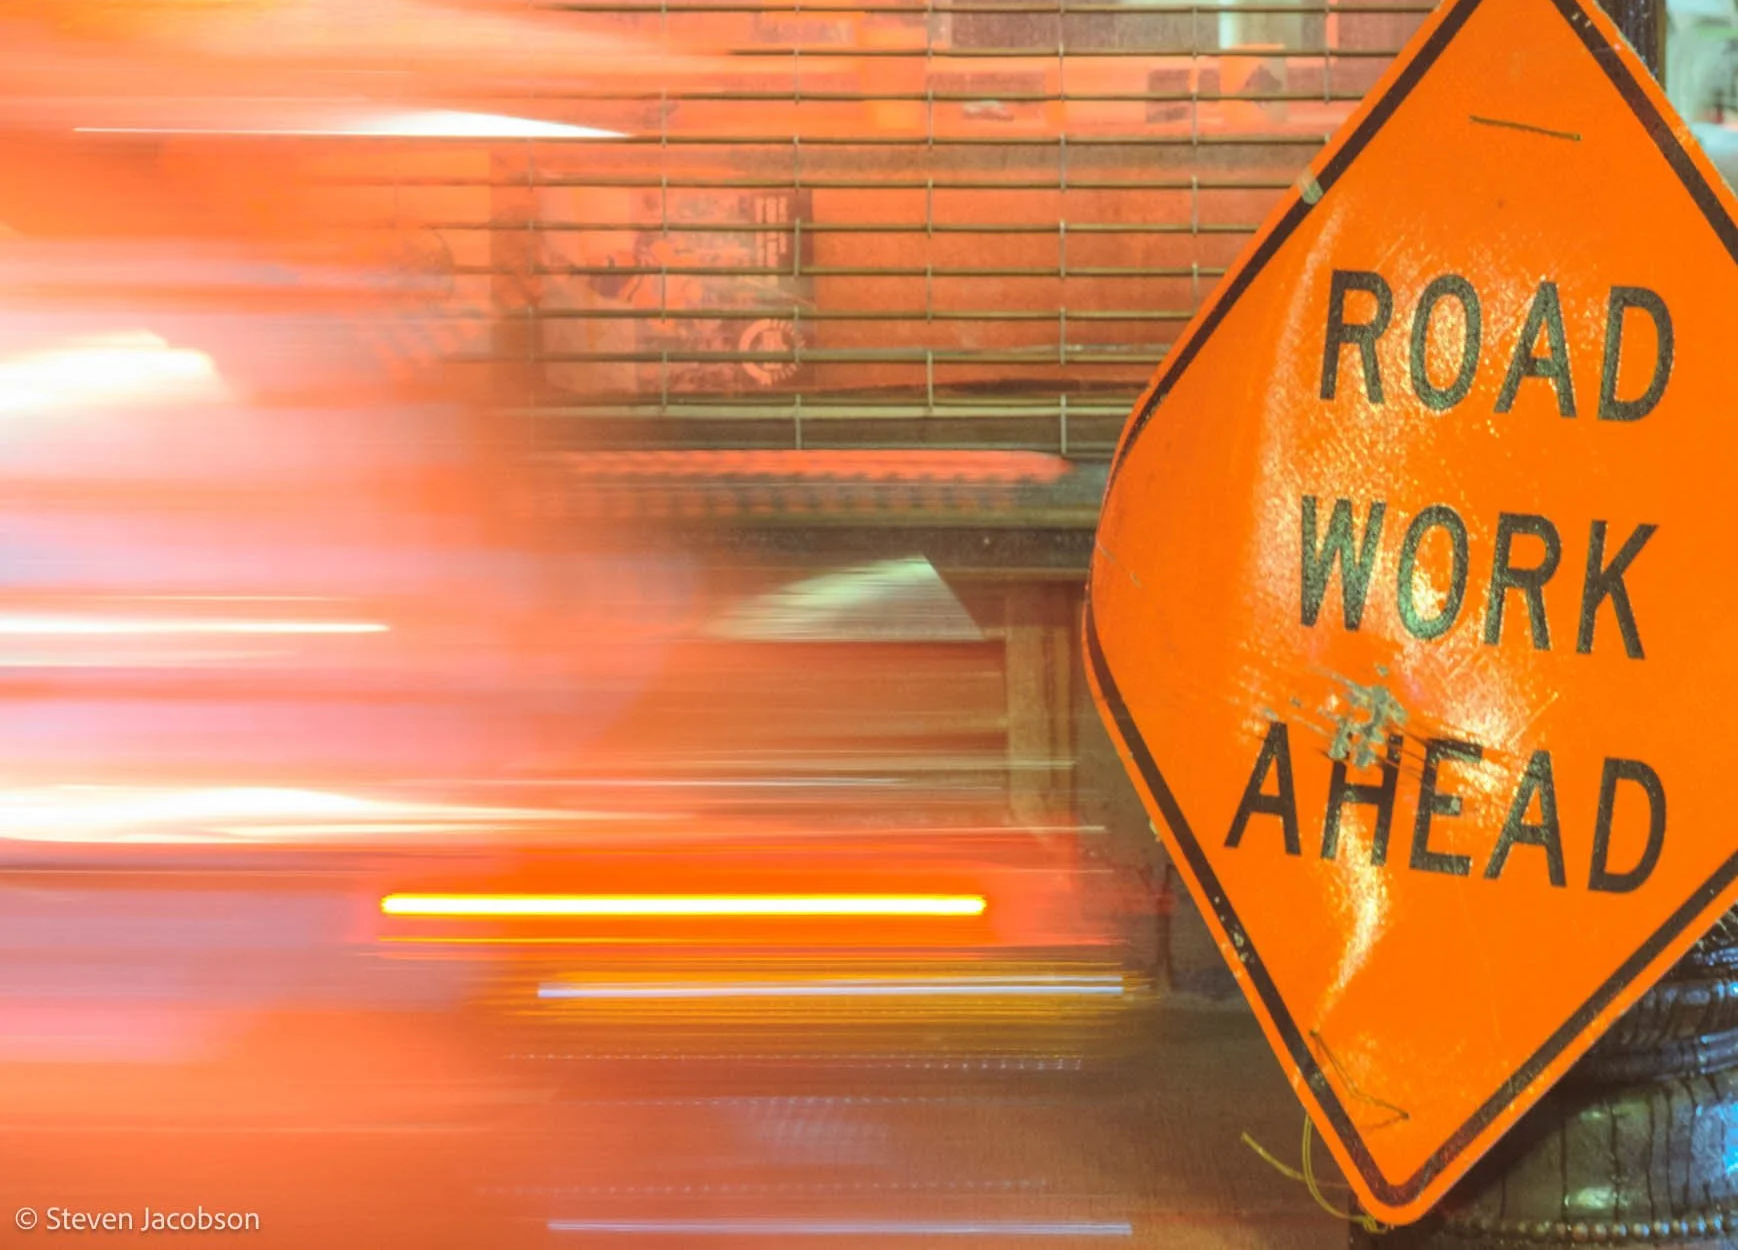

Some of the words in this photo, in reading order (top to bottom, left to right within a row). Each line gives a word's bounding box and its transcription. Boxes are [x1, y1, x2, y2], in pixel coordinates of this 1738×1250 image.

[1319, 269, 1676, 422] ROAD
[1299, 494, 1659, 660] WORK
[1223, 720, 1668, 894] AHEAD
